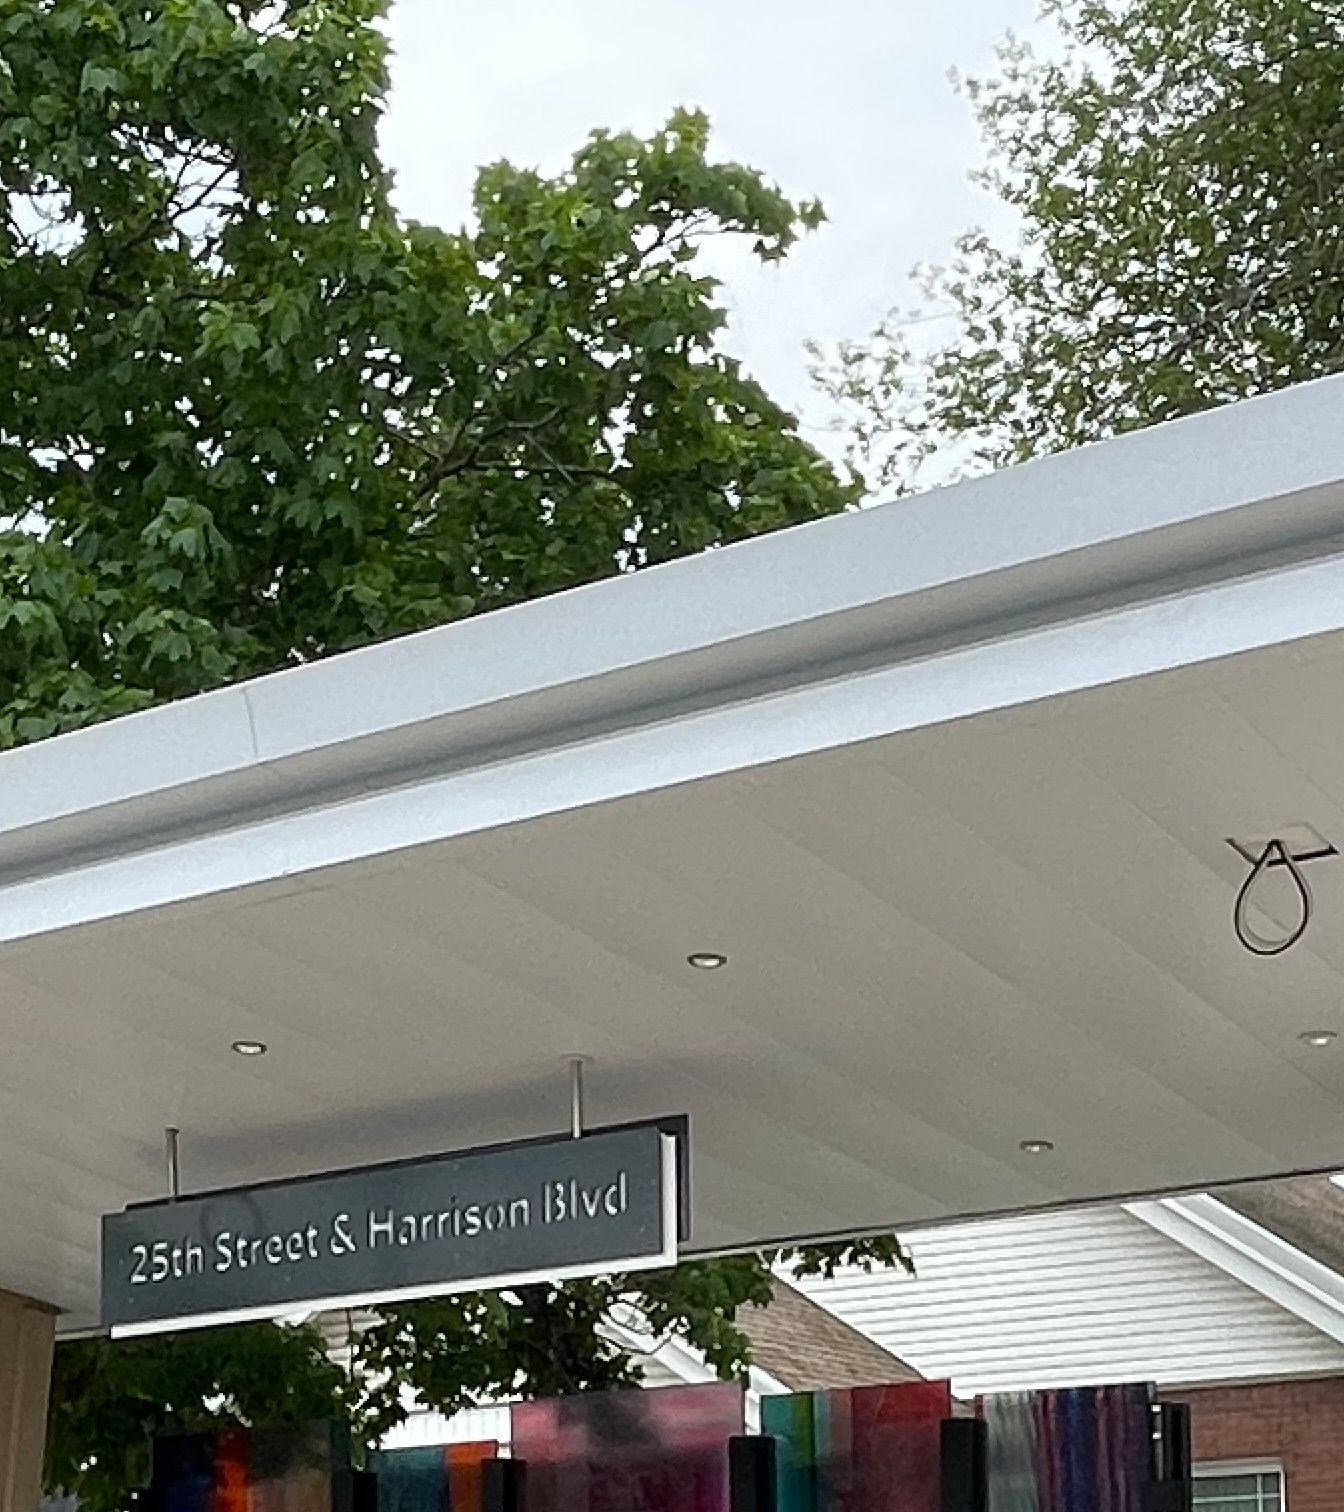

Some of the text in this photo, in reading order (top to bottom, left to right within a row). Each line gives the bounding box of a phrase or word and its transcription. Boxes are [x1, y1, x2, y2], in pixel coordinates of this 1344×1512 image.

[130, 1170, 627, 1284] 25th Street & Harrison Blvd
